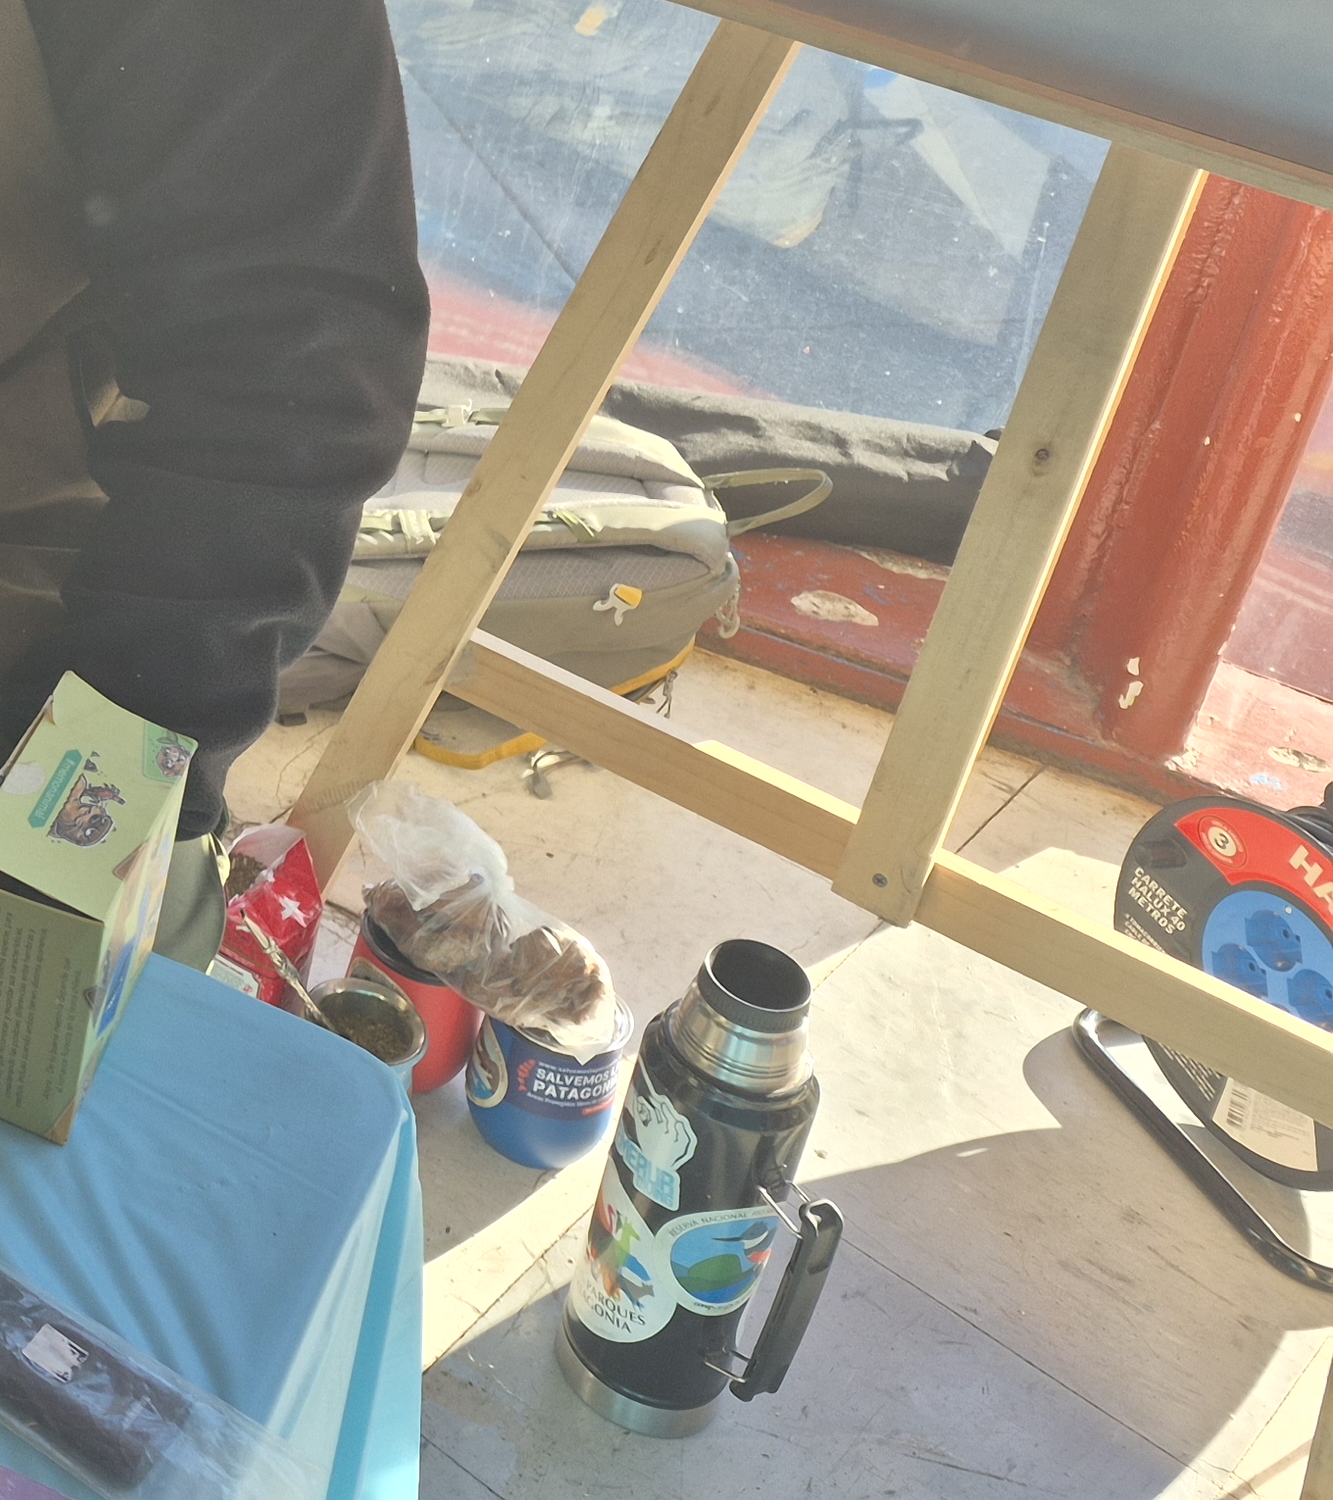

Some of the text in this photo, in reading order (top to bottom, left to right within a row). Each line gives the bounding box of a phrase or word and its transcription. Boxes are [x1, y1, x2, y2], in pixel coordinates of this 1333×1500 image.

[1214, 833, 1229, 849] 3
[1128, 888, 1176, 935] METROS
[1131, 878, 1186, 931] HALUX 40
[1134, 867, 1188, 918] CARRETE
[536, 1068, 609, 1086] SALVEMOS
